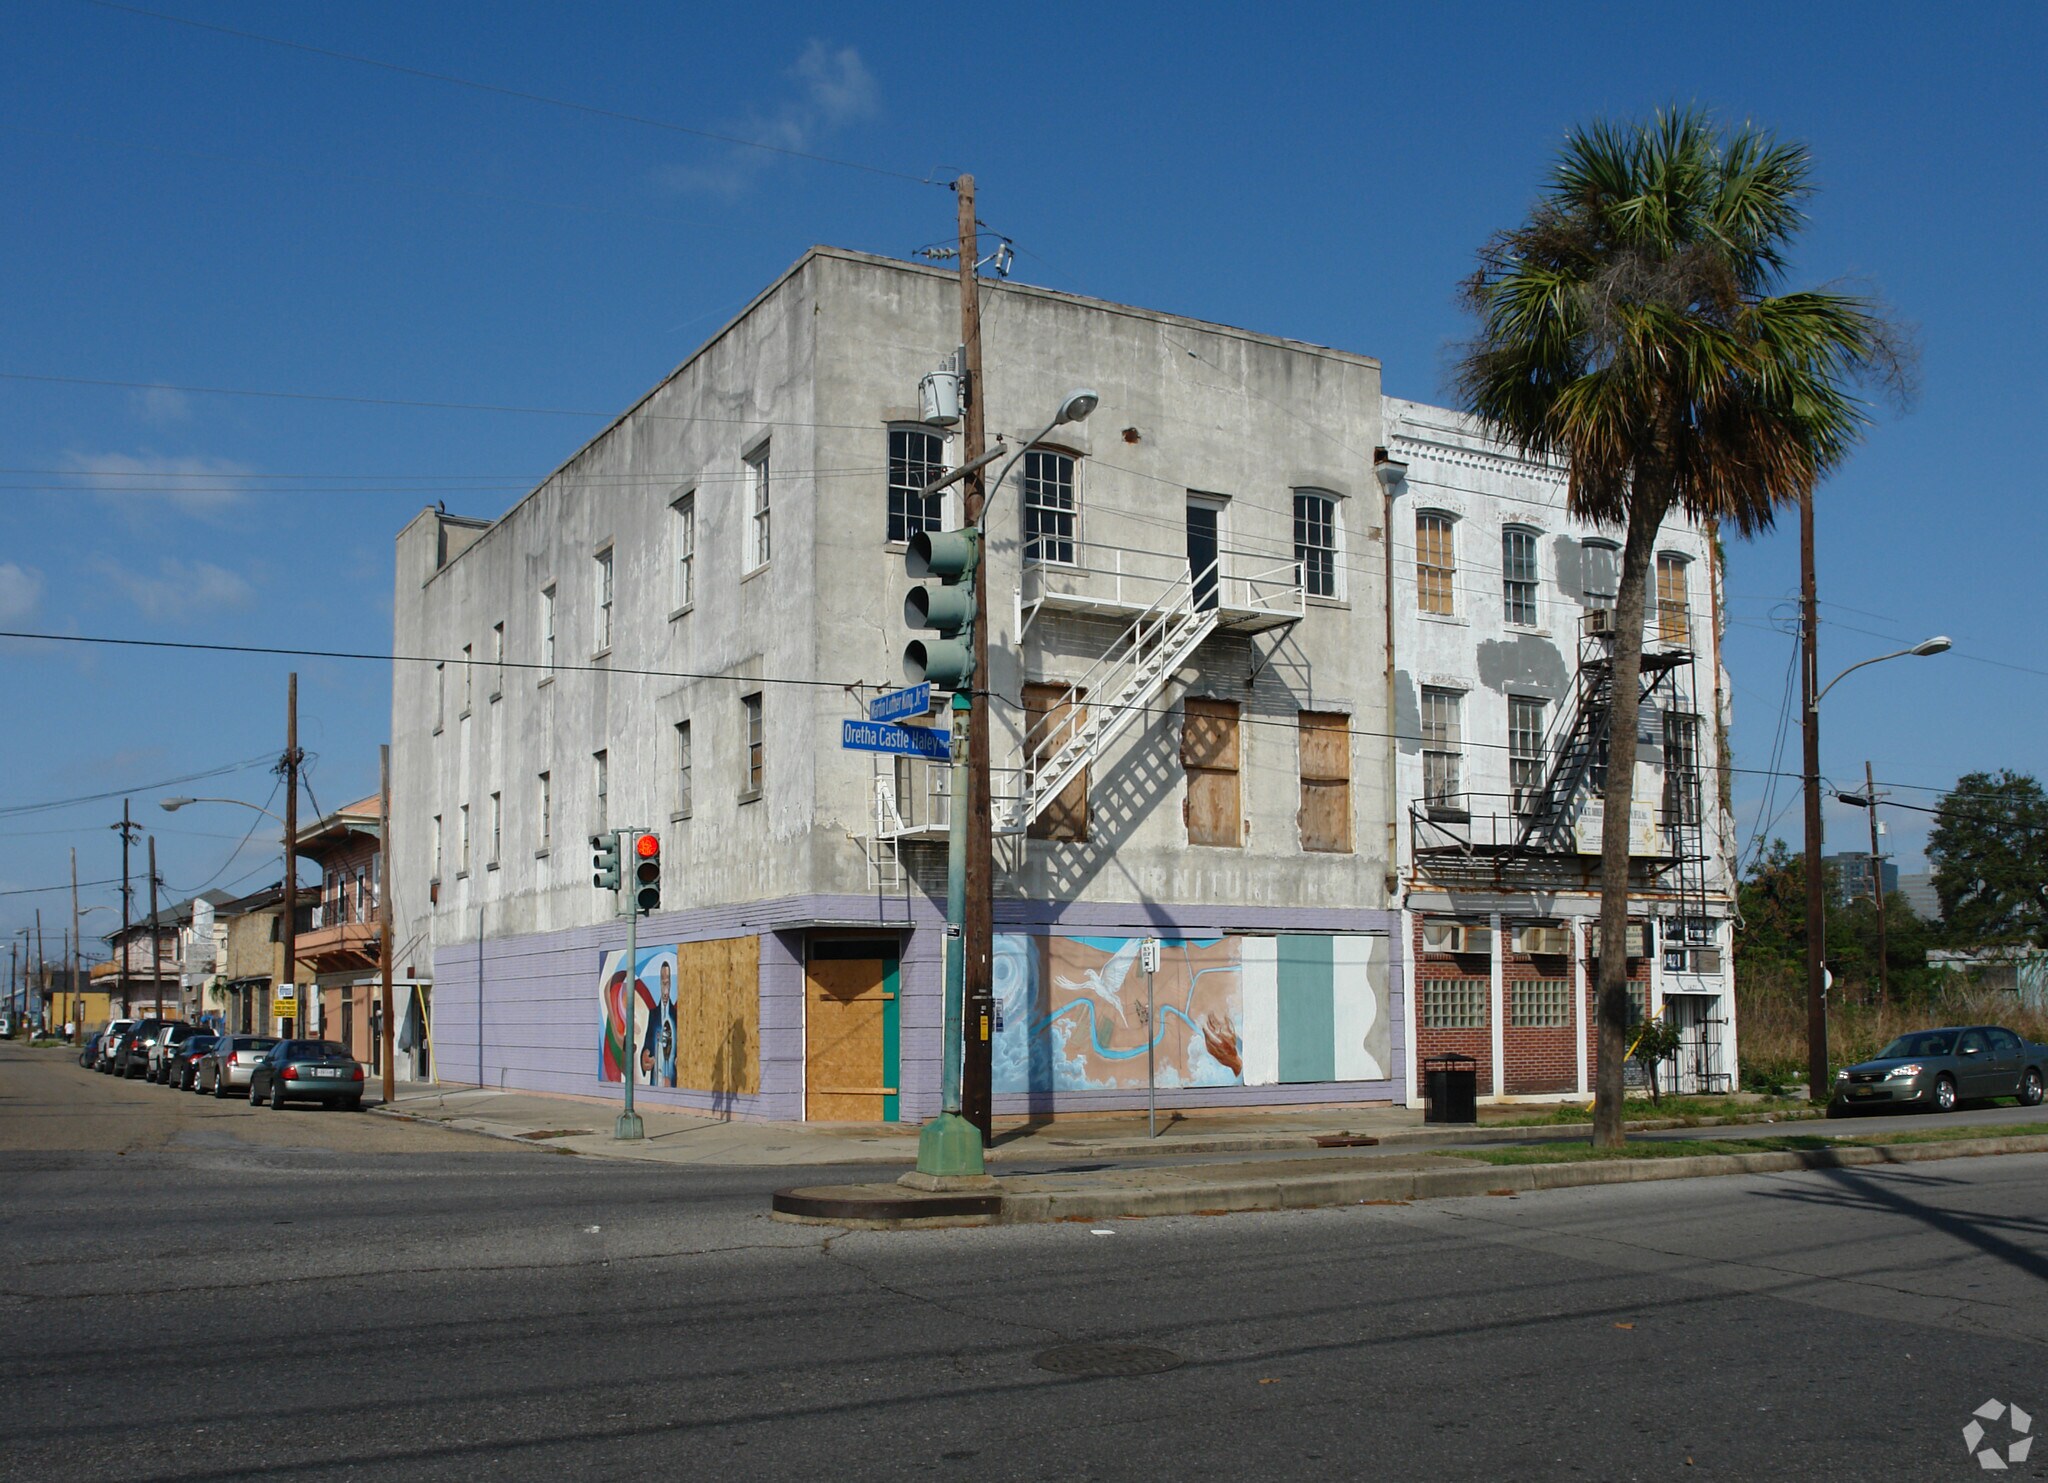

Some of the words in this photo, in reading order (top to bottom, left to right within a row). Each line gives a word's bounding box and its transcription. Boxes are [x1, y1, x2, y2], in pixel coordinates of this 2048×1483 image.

[844, 723, 876, 746] Oretha
[879, 726, 909, 749] Castle
[911, 730, 939, 756] Haley
